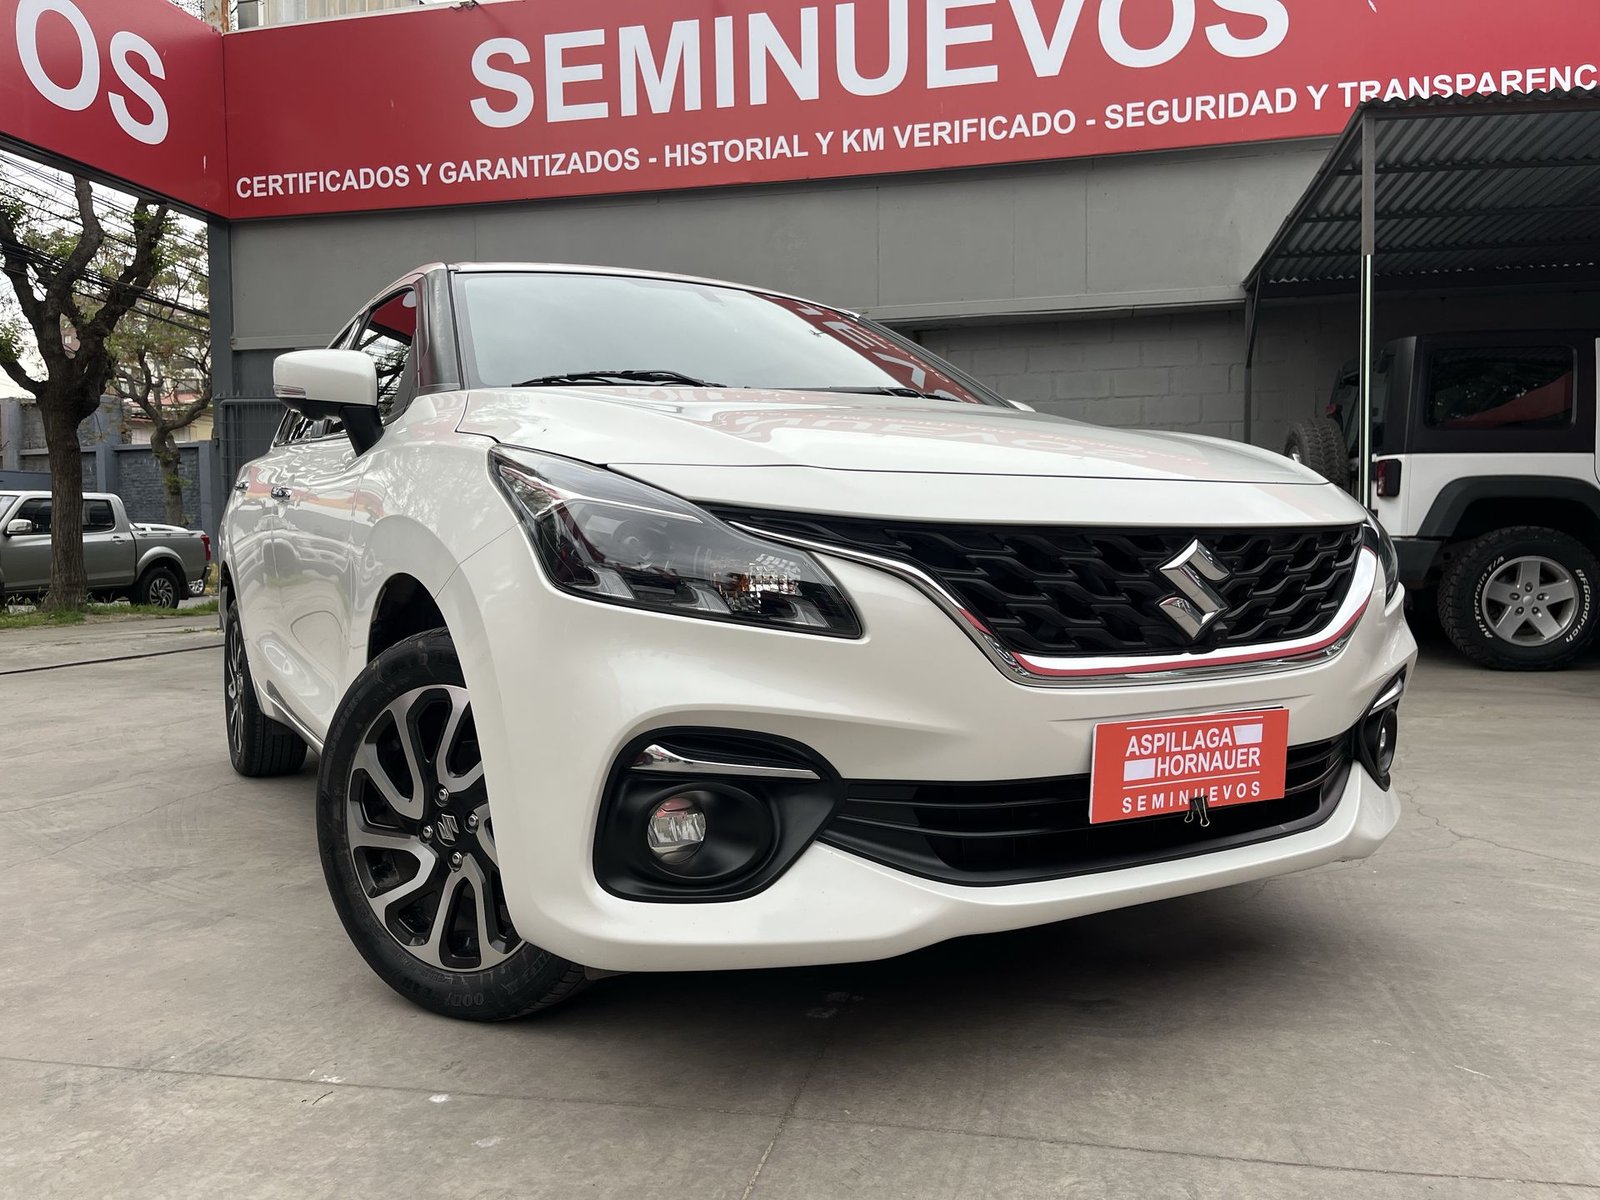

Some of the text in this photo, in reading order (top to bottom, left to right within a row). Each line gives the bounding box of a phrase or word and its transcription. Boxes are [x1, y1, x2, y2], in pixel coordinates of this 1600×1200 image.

[16, 0, 169, 145] OS
[471, 0, 1290, 128] SEMINUEVOS
[236, 165, 410, 198] CERTIFICADOS
[415, 163, 433, 185] Y
[439, 147, 641, 184] GARANTIZADOS
[664, 134, 809, 168] HISTORIAL
[815, 131, 834, 155] Y
[842, 127, 885, 154] KM
[892, 109, 1076, 149] VERIFICADO
[1104, 87, 1297, 130] SEGURIDAD
[1306, 84, 1329, 111] Y
[1565, 569, 1591, 643] BFGoodrich
[1125, 727, 1233, 757] ASPILLAGA
[1156, 747, 1261, 778] HORNAUER
[1122, 781, 1261, 814] SEMINUEVOS
